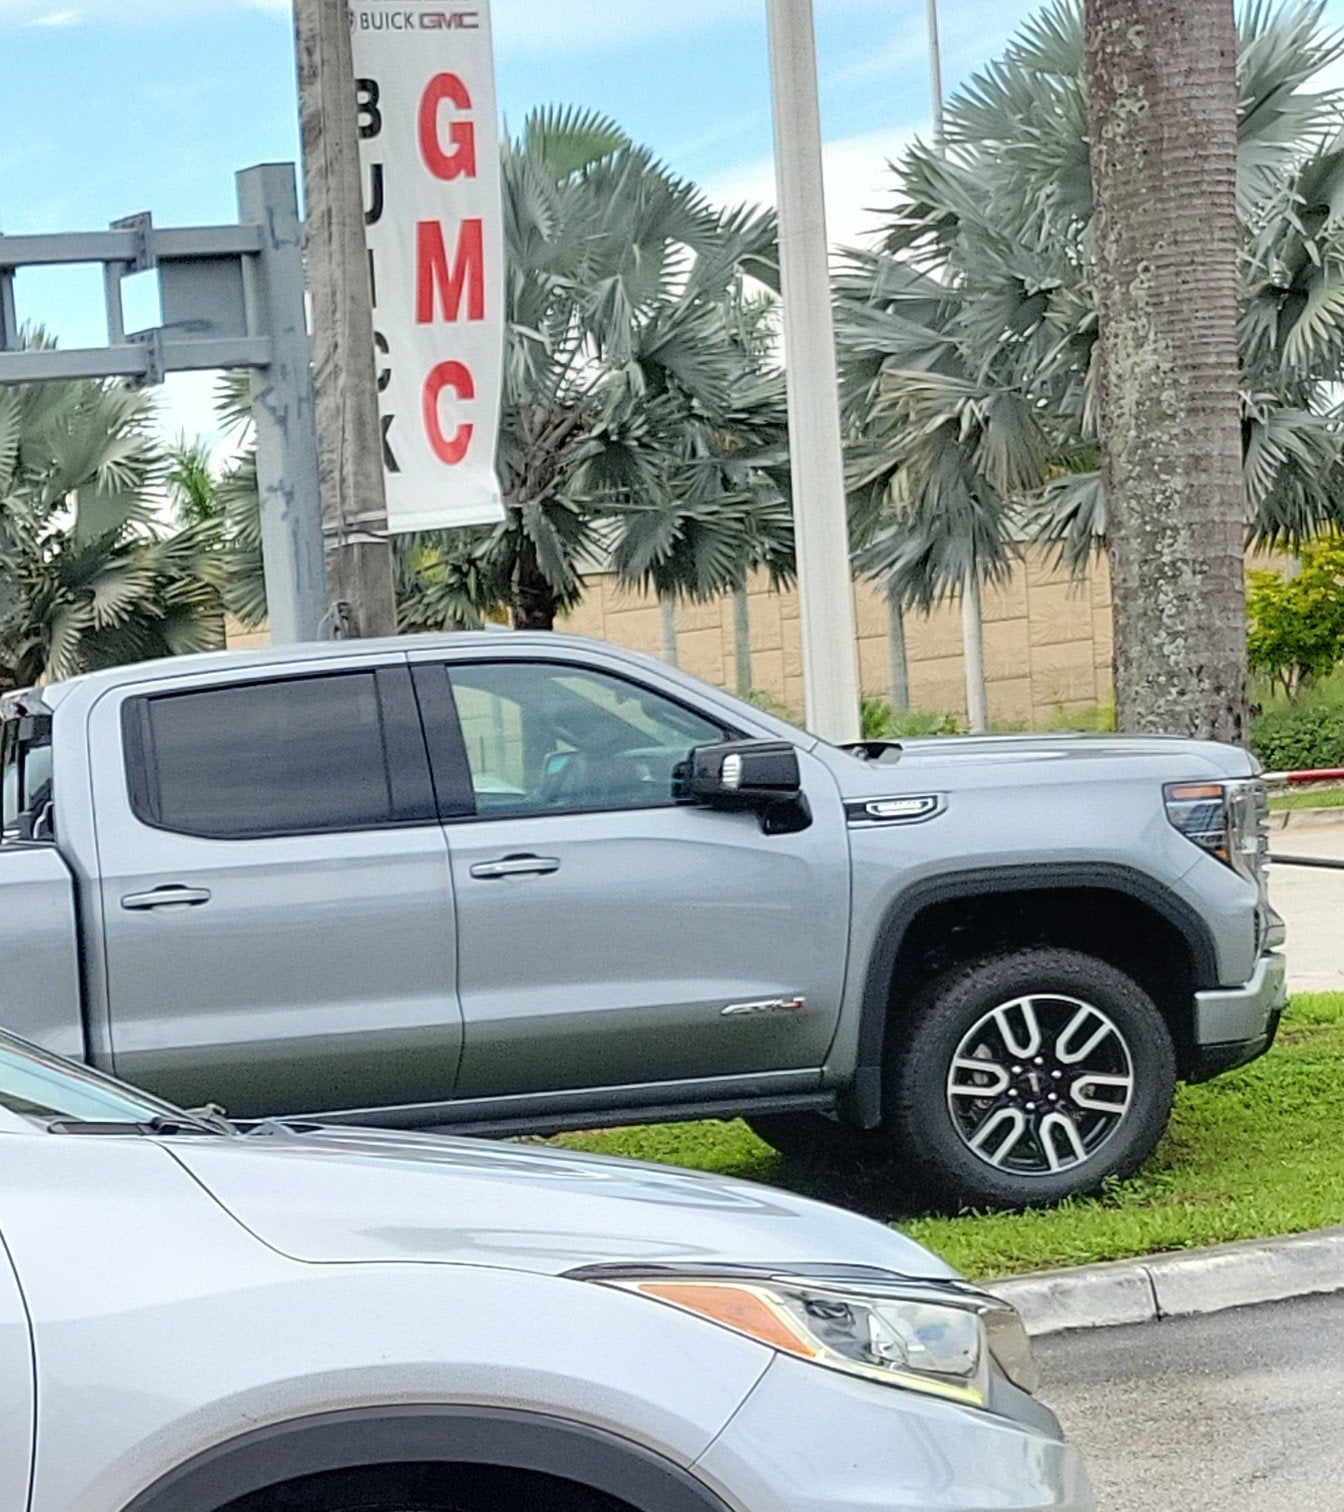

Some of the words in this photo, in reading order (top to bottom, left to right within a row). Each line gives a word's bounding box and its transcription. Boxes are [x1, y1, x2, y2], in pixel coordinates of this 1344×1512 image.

[360, 12, 414, 29] BUICK
[419, 12, 479, 29] GMC
[416, 72, 485, 466] GMC
